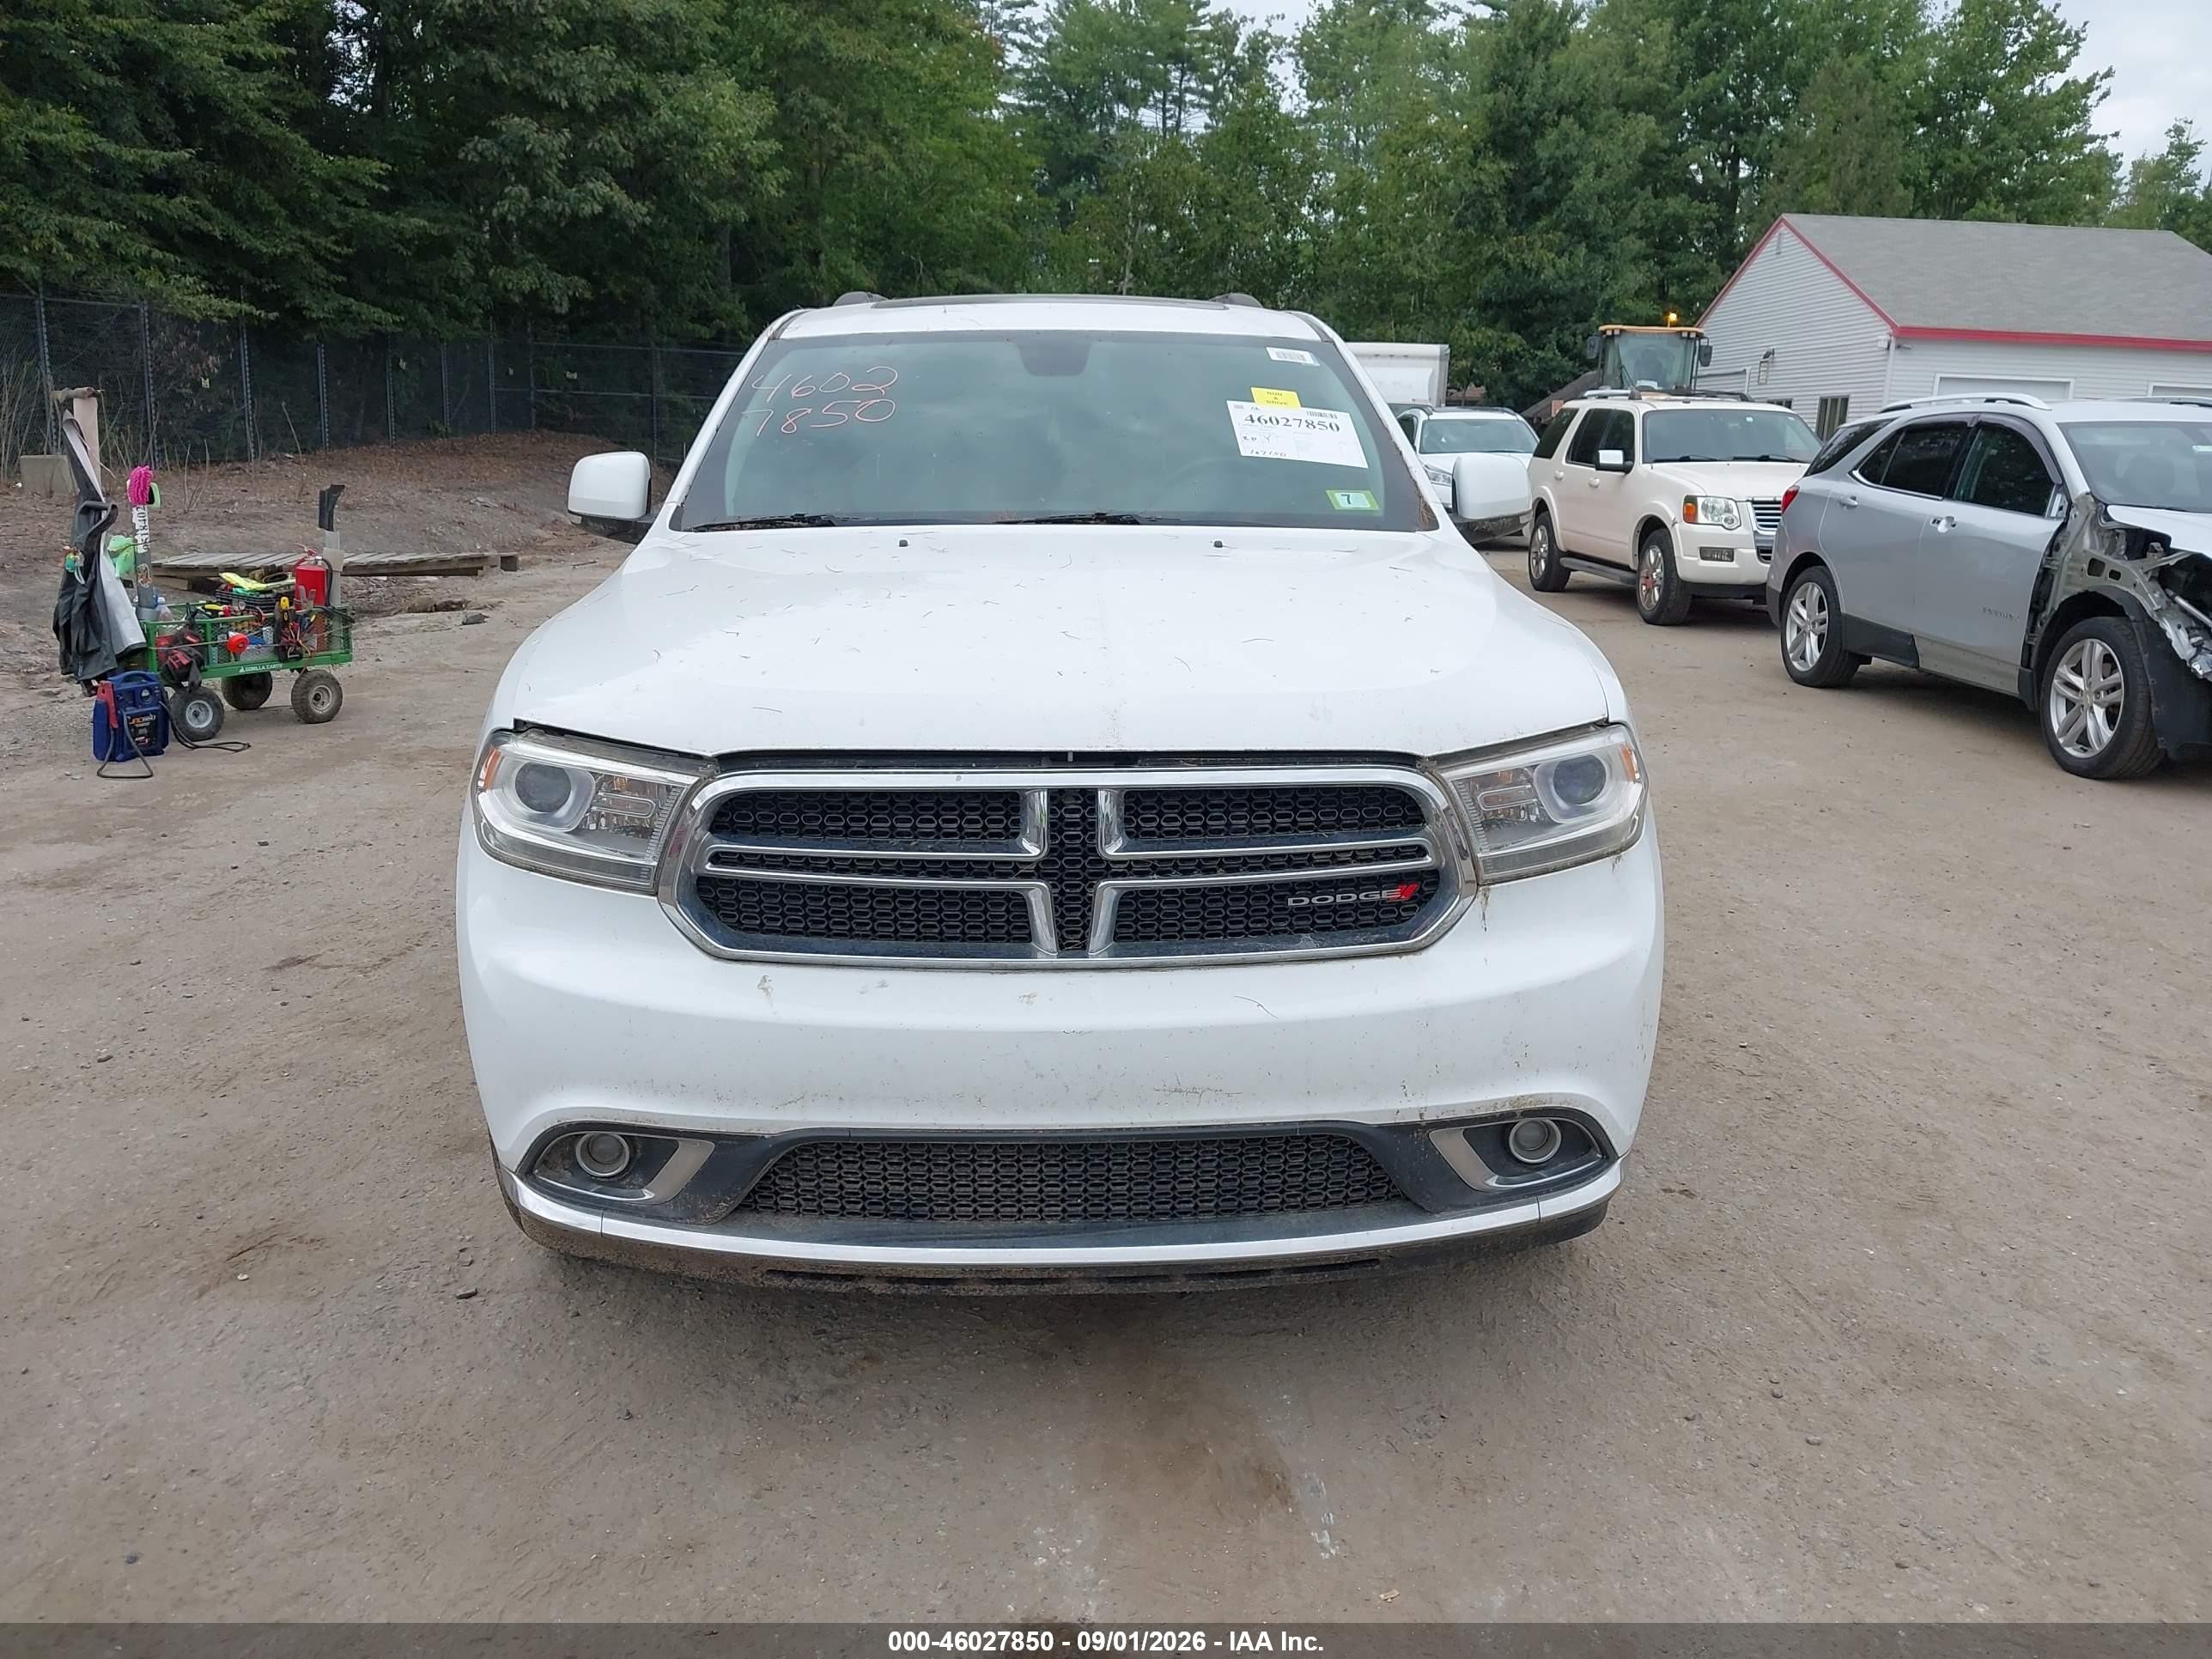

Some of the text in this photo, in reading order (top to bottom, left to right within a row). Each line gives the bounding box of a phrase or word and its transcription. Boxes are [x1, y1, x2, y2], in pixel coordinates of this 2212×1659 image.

[751, 366, 898, 403] 4602
[742, 398, 896, 437] 7850
[1243, 413, 1340, 433] 46027850
[1340, 494, 1352, 505] 7
[1287, 888, 1401, 907] DODGE
